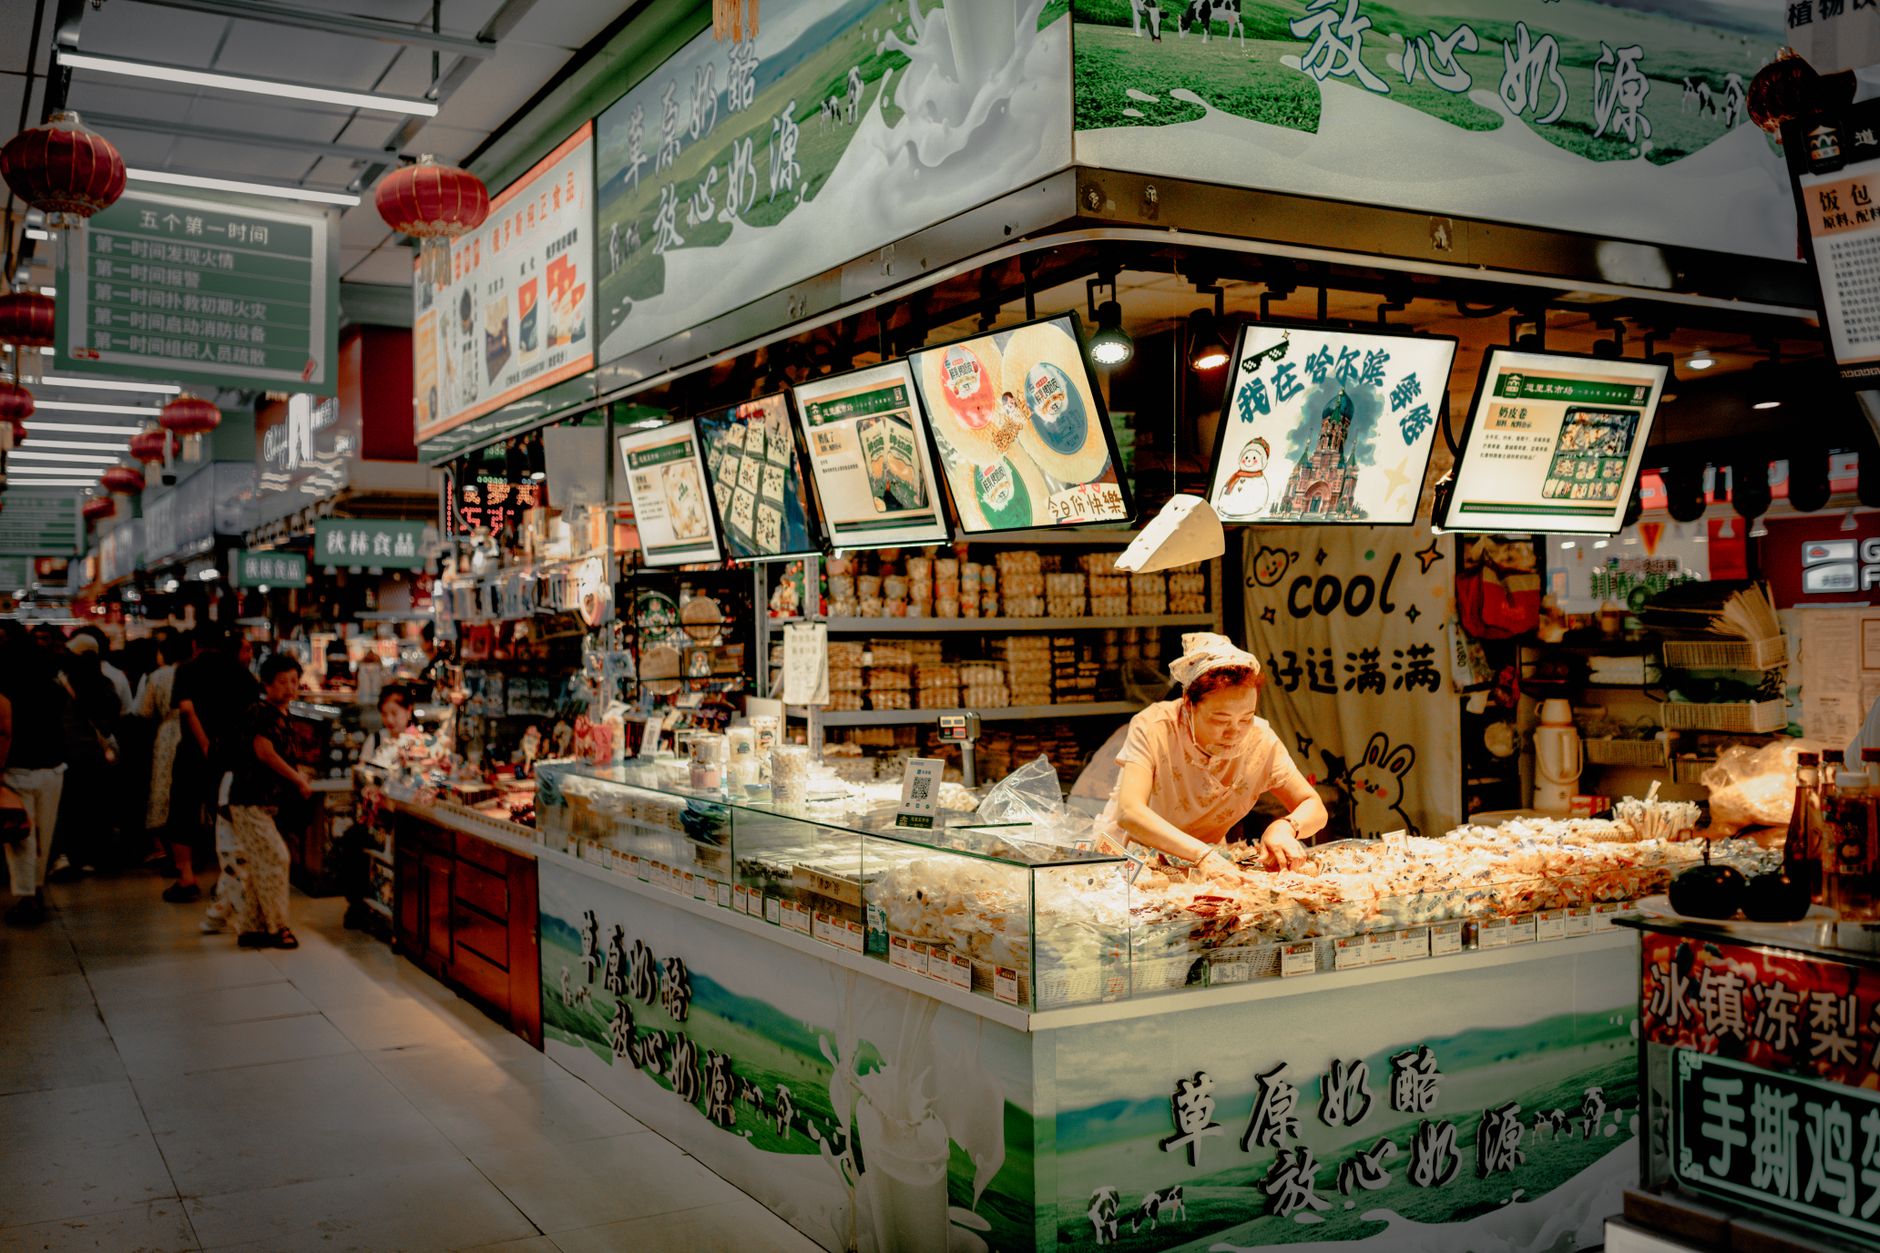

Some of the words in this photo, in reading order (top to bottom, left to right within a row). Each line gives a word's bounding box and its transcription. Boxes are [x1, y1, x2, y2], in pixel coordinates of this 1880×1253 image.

[1289, 0, 1652, 143] 放心奶源
[139, 210, 269, 245] 五个第一时间
[652, 100, 800, 255] 放心奶源
[94, 235, 234, 269] 第一时间发现火情
[94, 259, 200, 289] 第一时间报警
[326, 530, 416, 557] 秋林食品
[580, 910, 692, 1022] 草原奶酪
[1649, 962, 1880, 1071] 冰镇冻梨
[609, 1000, 737, 1127] 放心奶源
[1159, 1044, 1443, 1167] 草原奶酪
[1258, 1101, 1528, 1217] 放心奶源
